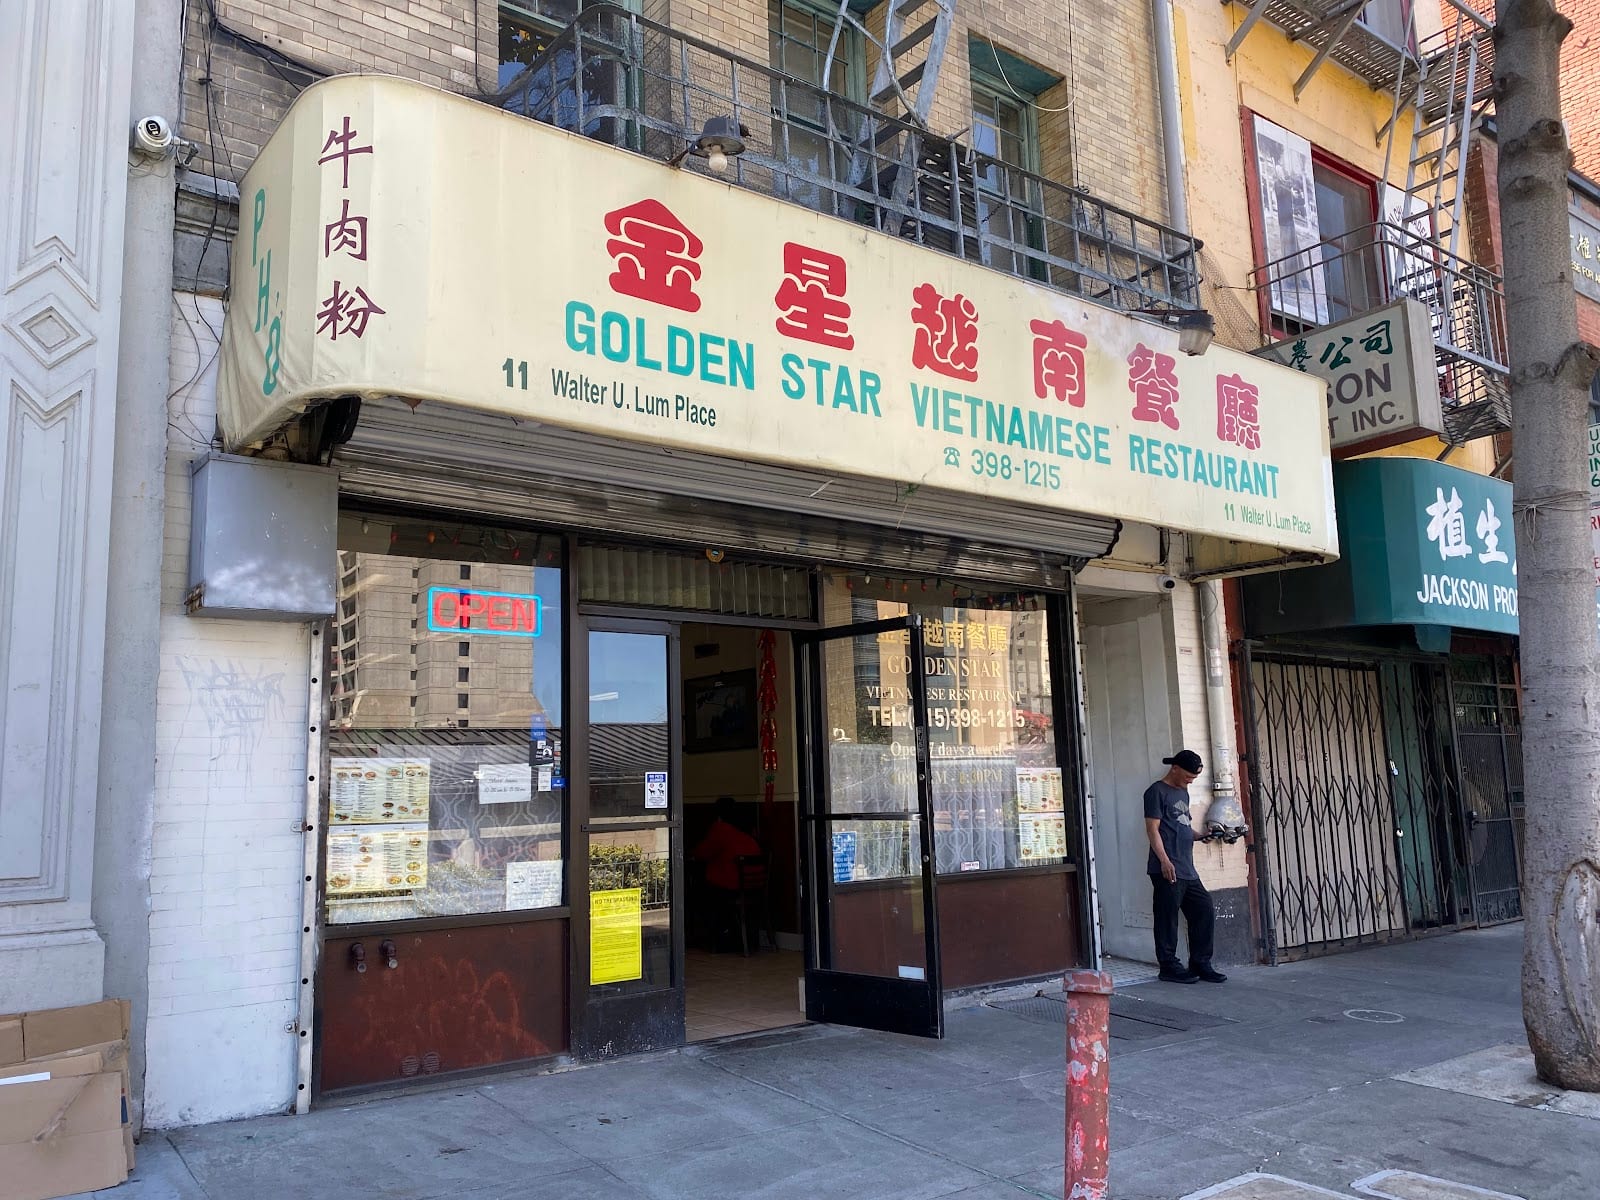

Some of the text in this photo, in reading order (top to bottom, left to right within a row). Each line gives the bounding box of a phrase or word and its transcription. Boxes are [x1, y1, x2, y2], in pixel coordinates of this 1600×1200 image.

[316, 116, 387, 341] 牛肉粉
[604, 197, 1261, 450] 金星越南餐廳
[502, 358, 717, 427] 11 Walter U. Lum Place
[565, 300, 1279, 499] GOLDEN STAR VIETNAMESE RESTAURANT
[1351, 401, 1405, 433] INC.
[970, 448, 1062, 491] 398-1215
[1223, 503, 1236, 522] 11
[1240, 505, 1265, 526] Walter
[1275, 512, 1292, 530] Lum
[1292, 514, 1312, 535] Place
[434, 592, 535, 632] OPEN
[1416, 574, 1519, 617] JACKSON PRO
[887, 655, 1001, 678] GODEN STAR
[866, 685, 1022, 703] VIETNAESE RESTAURANT
[867, 705, 1025, 731] TEL:(15)398-1215
[890, 741, 916, 759] Ope
